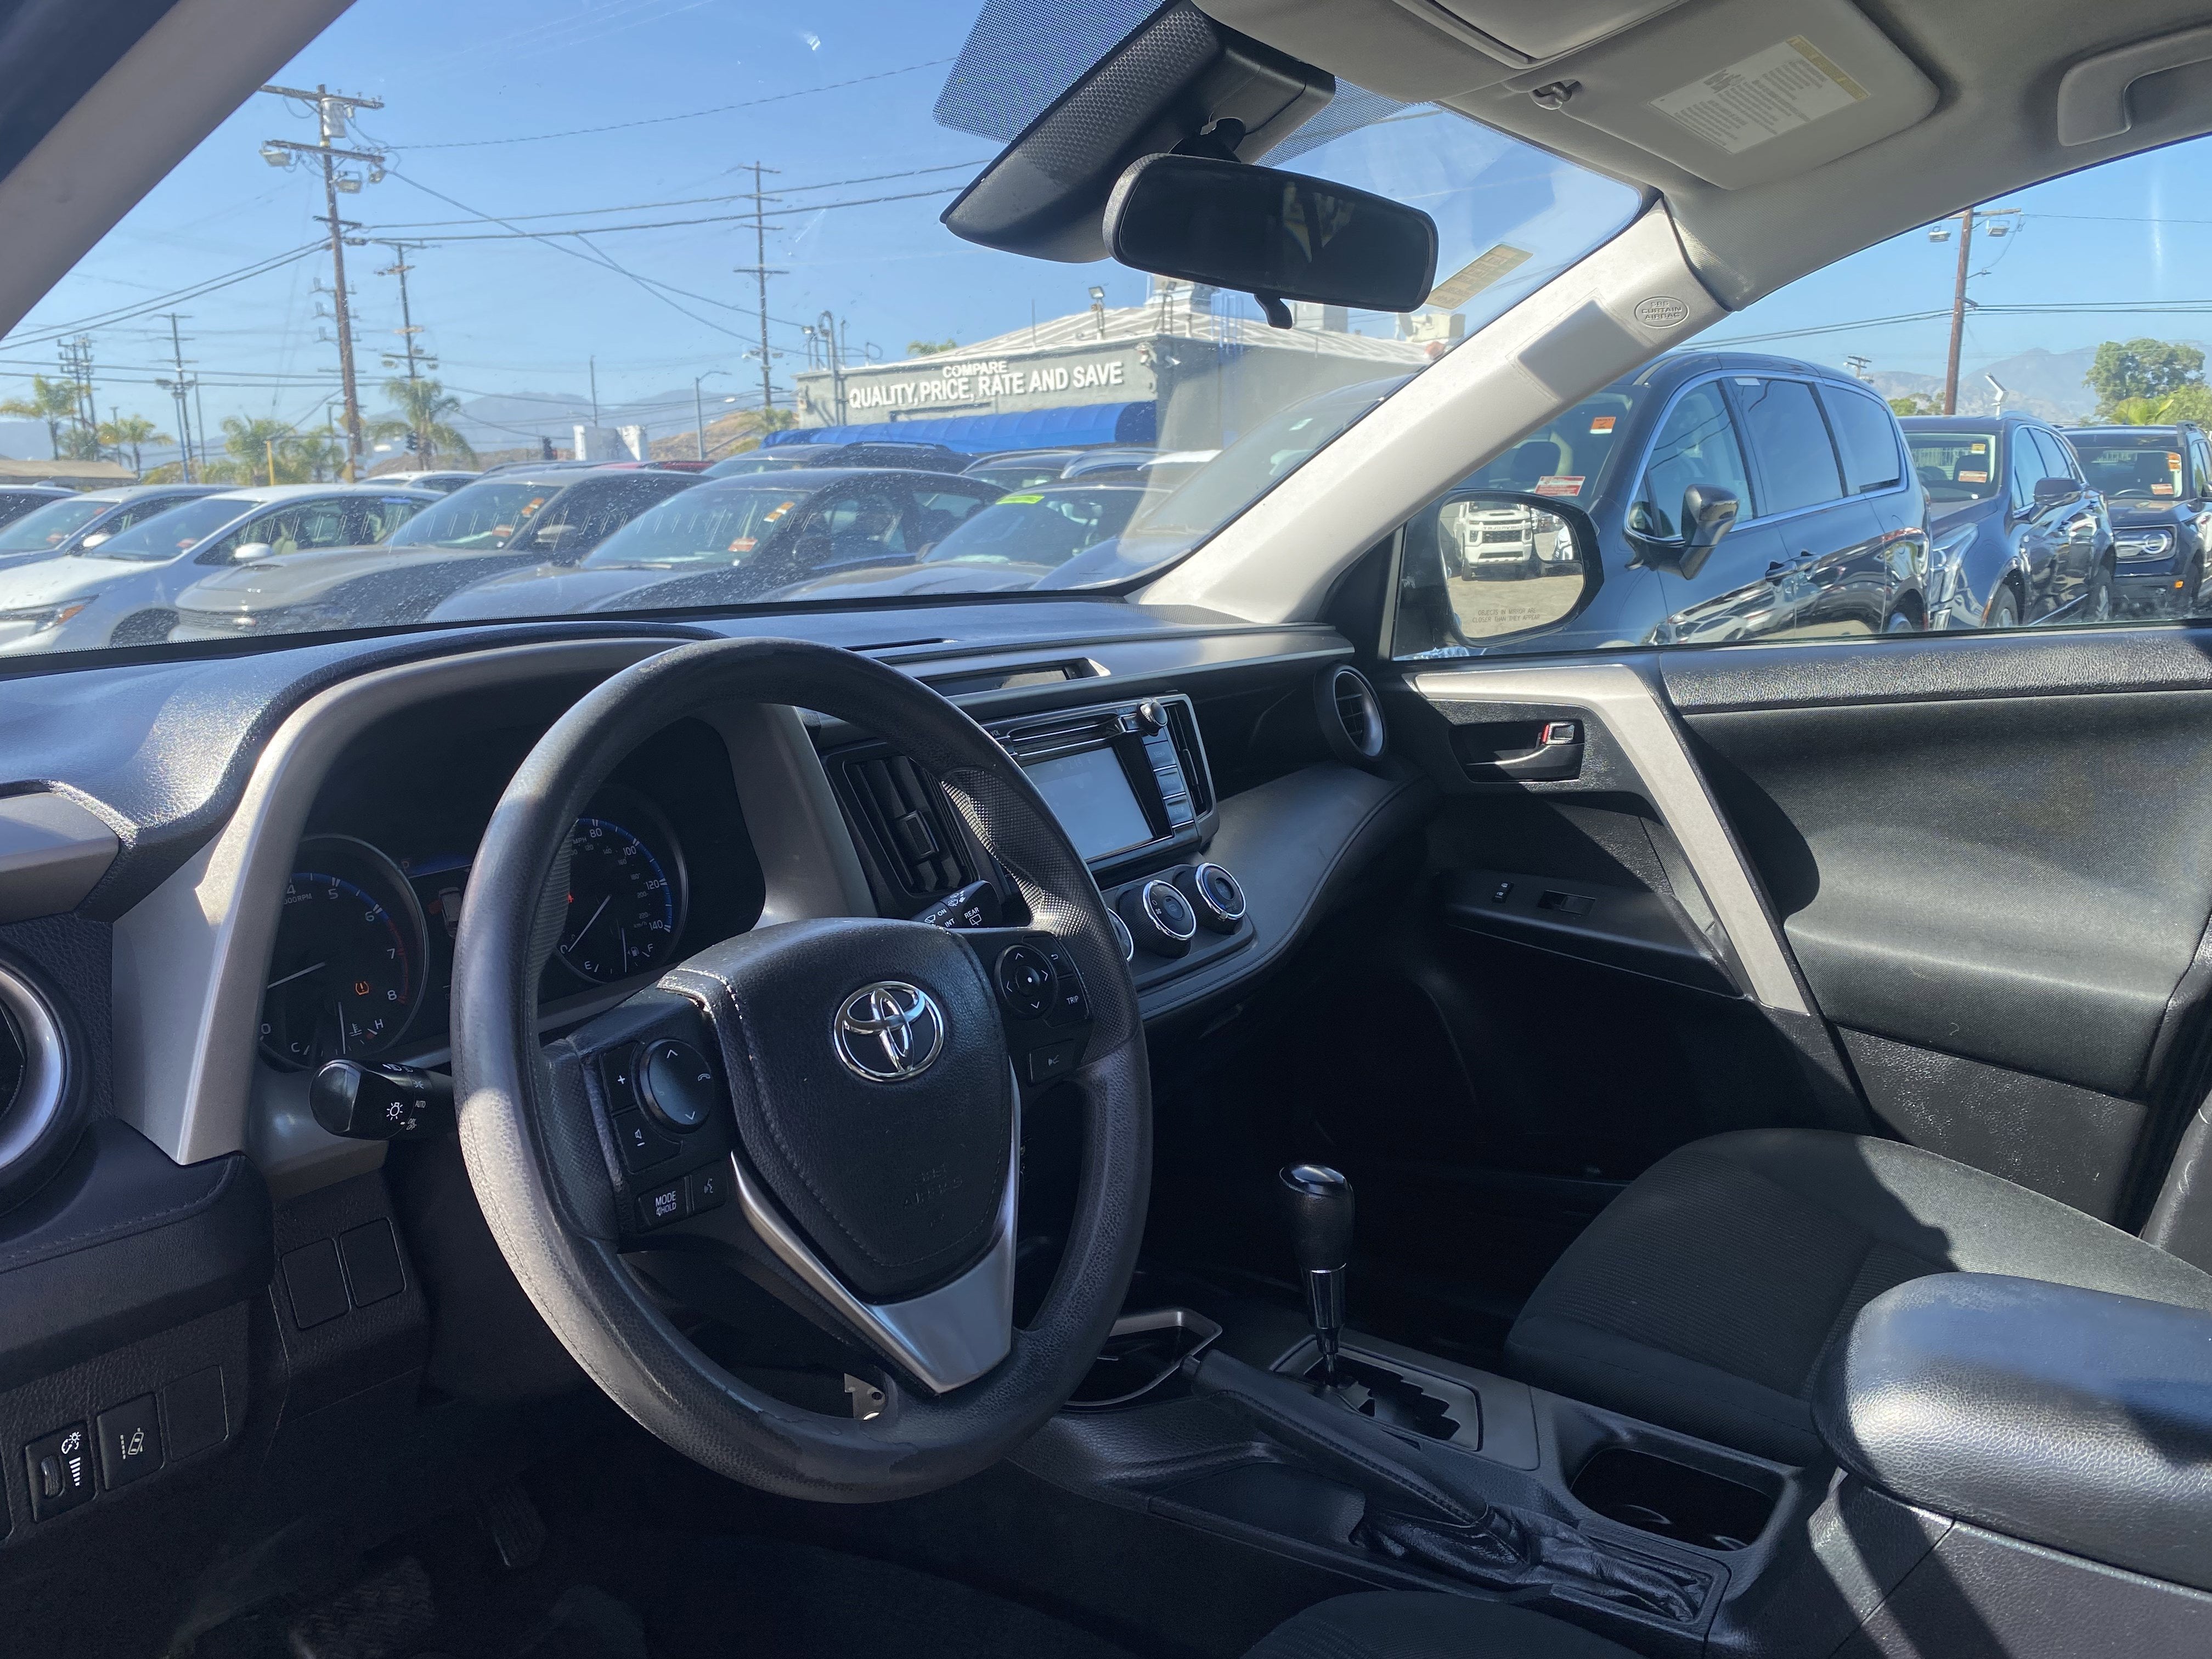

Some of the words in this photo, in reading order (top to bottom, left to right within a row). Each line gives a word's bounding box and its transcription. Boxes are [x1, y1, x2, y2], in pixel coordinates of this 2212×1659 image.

[943, 361, 1008, 378] COMPARE
[849, 382, 918, 409] QUALITY,
[920, 377, 974, 402] PRICE,
[978, 373, 1025, 397] RATE
[1029, 367, 1069, 393] AND
[1073, 362, 1124, 388] SAVE
[589, 827, 602, 838] 80
[572, 837, 588, 845] MPH
[623, 845, 636, 856] 100
[286, 884, 296, 895] 4
[645, 879, 660, 890] 120
[328, 889, 338, 900] 5
[365, 911, 375, 922] 6
[964, 907, 980, 919] REAR
[648, 919, 663, 931] 140
[944, 918, 955, 928] INT
[647, 943, 654, 953] F
[386, 948, 396, 960] 7
[584, 960, 592, 970] E
[387, 990, 397, 1001] 8
[1066, 995, 1079, 1005] TRIP
[261, 1023, 272, 1035] 0
[374, 1018, 384, 1030] H
[291, 1042, 301, 1053] C
[415, 1100, 426, 1108] AUTO
[655, 1190, 676, 1207] MODE
